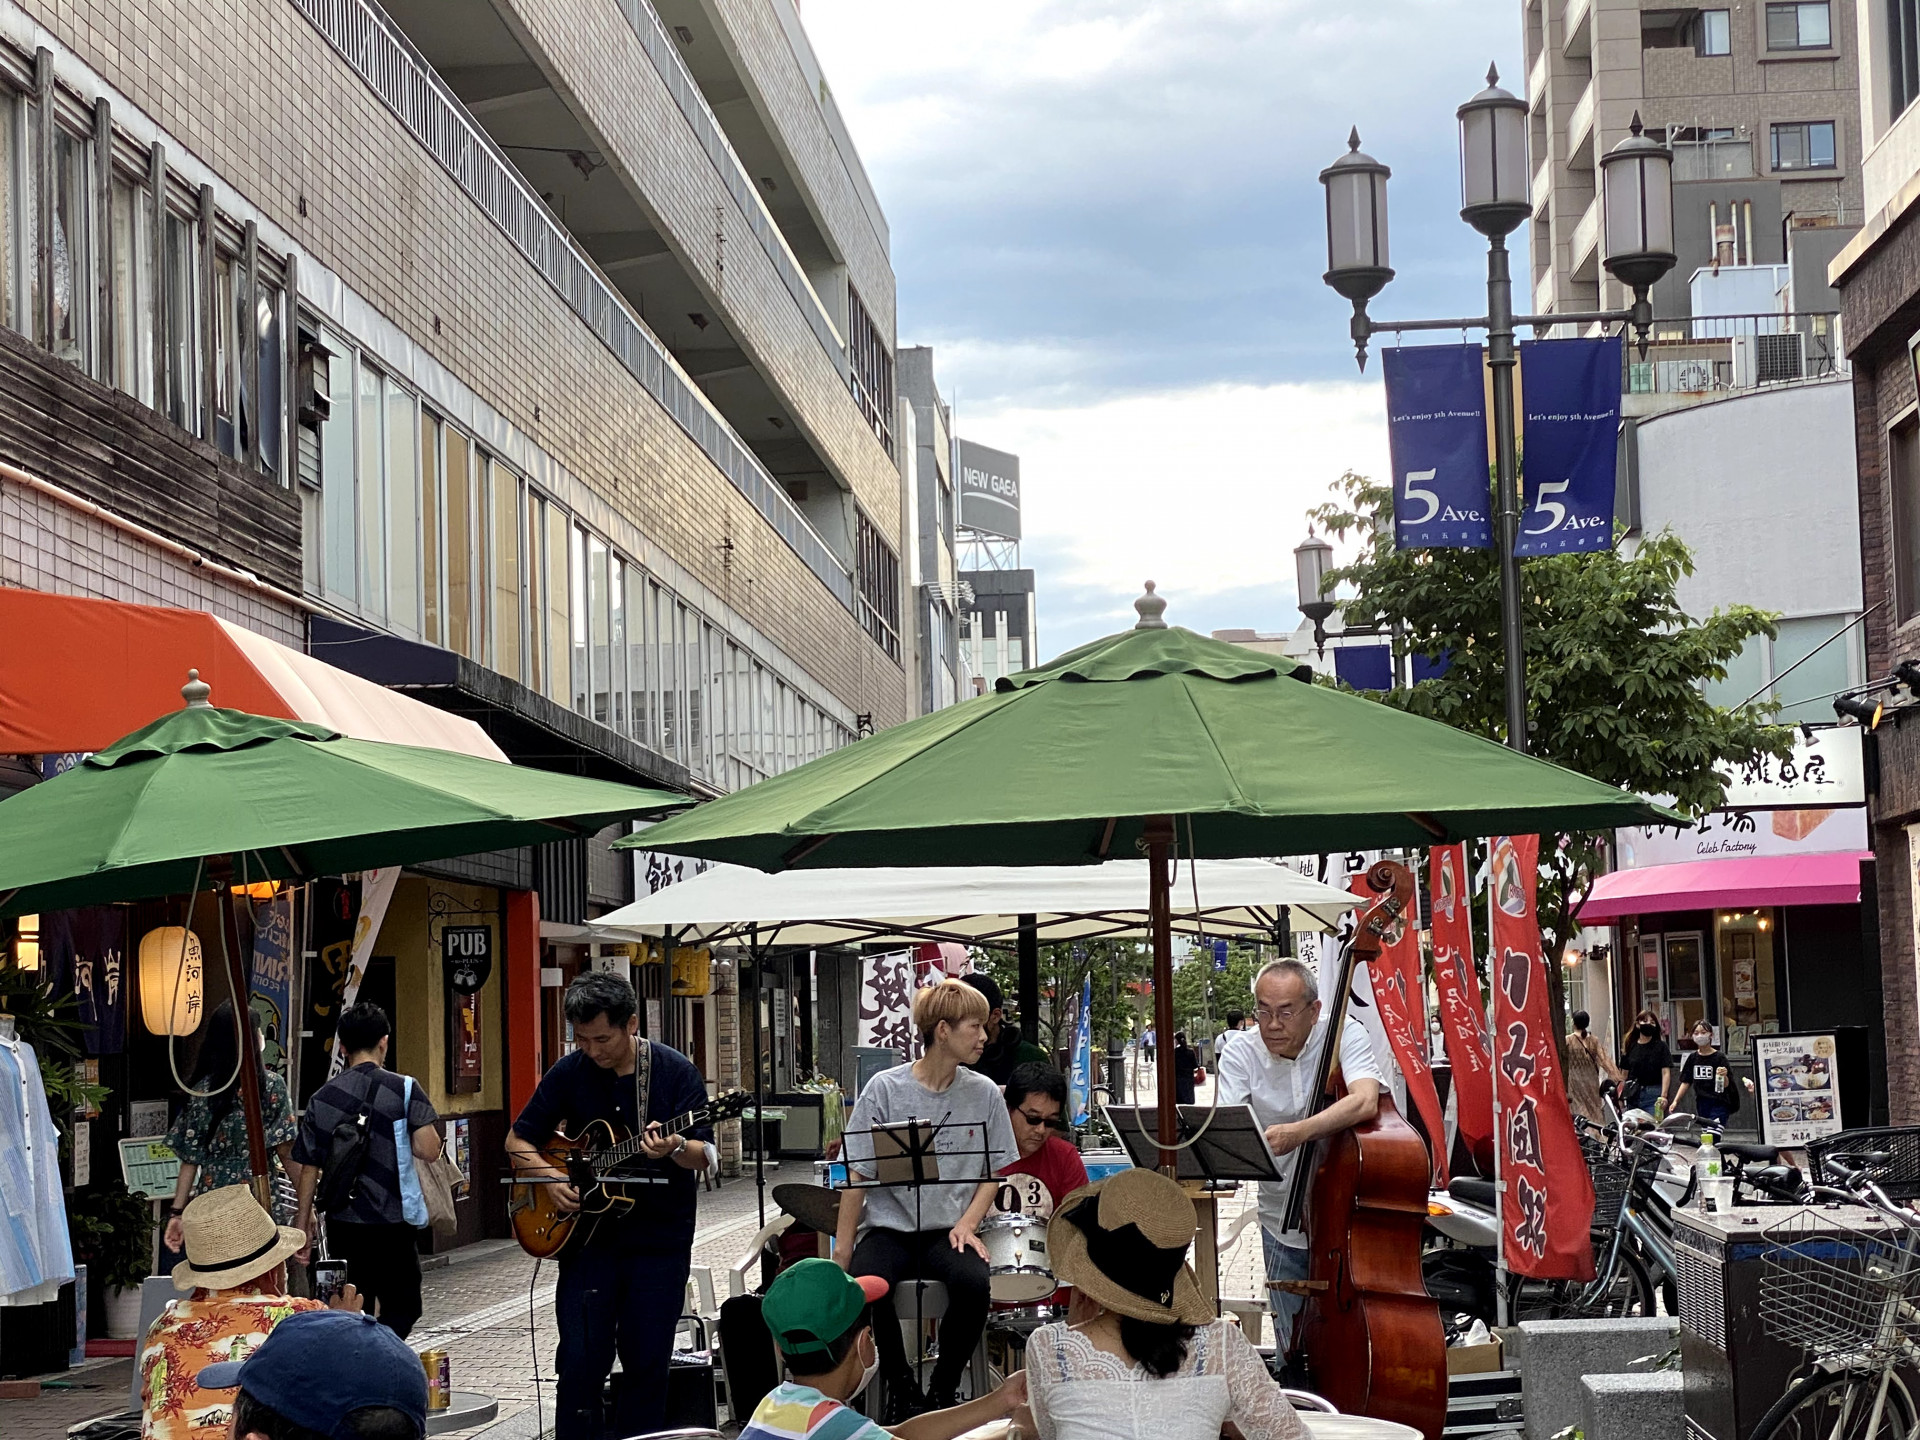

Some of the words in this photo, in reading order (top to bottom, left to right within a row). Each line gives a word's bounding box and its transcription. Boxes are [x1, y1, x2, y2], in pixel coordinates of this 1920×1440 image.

[1393, 413, 1411, 422] Let's
[1412, 412, 1432, 421] enjoy
[1434, 410, 1446, 419] 5th
[1447, 410, 1480, 418] Avenue!!
[1529, 413, 1547, 421] Let's
[1547, 413, 1568, 422] enjoy
[1570, 413, 1582, 421] 5th
[1583, 409, 1614, 421] Avenue!!
[963, 466, 989, 491] NEW
[991, 475, 1018, 498] GAEA
[1400, 467, 1440, 525] 5
[1440, 504, 1486, 523] Ave.
[1524, 478, 1570, 535] 5
[1562, 514, 1605, 531] Ave.
[1697, 841, 1718, 855] Celeb
[1720, 839, 1757, 855] Factory
[448, 933, 487, 956] PUB
[1695, 1065, 1713, 1079] LEE
[1028, 1181, 1041, 1205] 3
